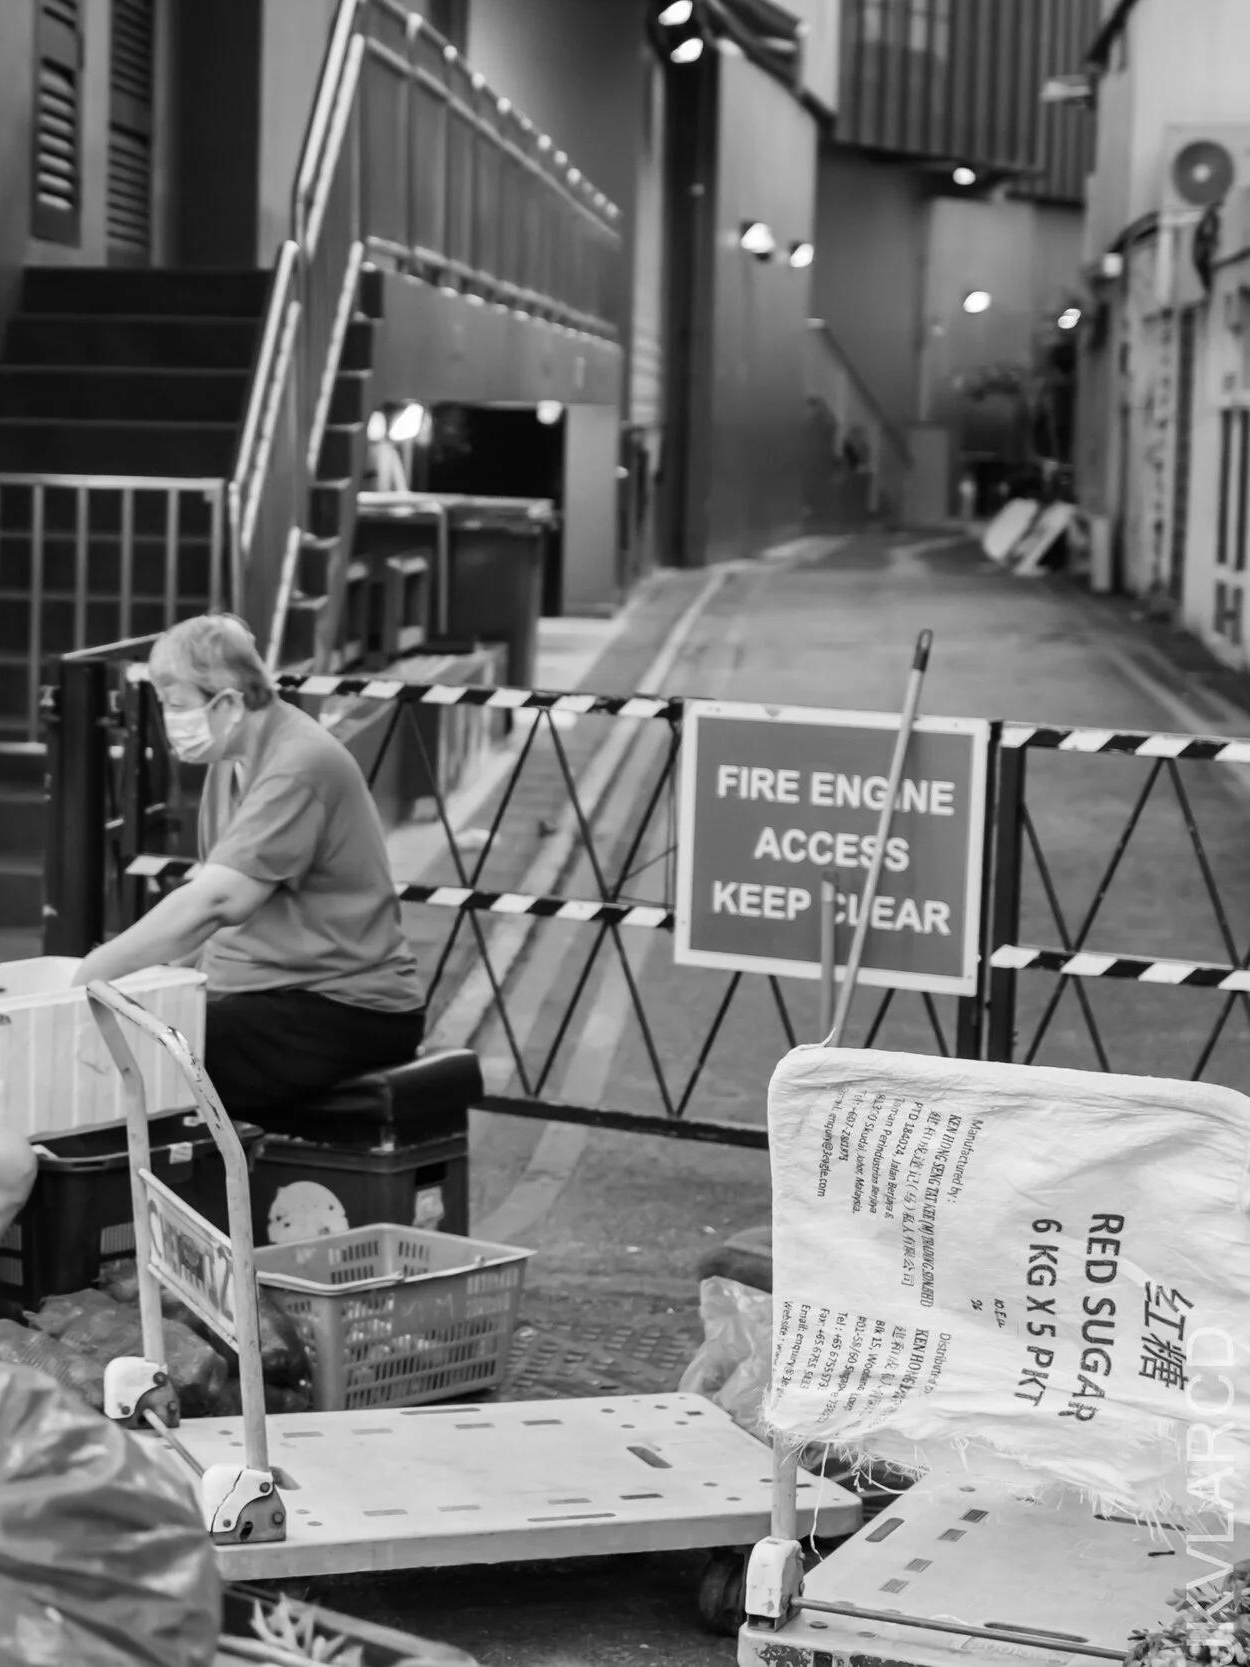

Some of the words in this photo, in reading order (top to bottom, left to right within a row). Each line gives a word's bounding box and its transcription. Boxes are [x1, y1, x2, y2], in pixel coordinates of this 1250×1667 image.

[717, 764, 800, 804] FIRE
[810, 771, 955, 816] ENGNE
[754, 826, 910, 872] ACCESS
[711, 880, 811, 920] KEEP
[909, 1101, 924, 1121] PTD
[946, 1114, 962, 1135] KEN
[892, 1121, 916, 1158] 184024,
[938, 1134, 955, 1162] HONG
[953, 1118, 984, 1187] Manufactured
[872, 1128, 892, 1184] Perindustrian
[888, 1158, 902, 1182] Jalan
[930, 1161, 946, 1187] SENG
[852, 1176, 865, 1214] Malaysia.
[884, 1181, 899, 1211] Berjaya
[925, 1187, 940, 1203] TAT
[923, 1203, 937, 1221] KEE
[1031, 1218, 1063, 1234] 6
[918, 1220, 935, 1235] (M)
[1087, 1213, 1125, 1284] RED
[1026, 1244, 1059, 1287] KG
[779, 1300, 794, 1337] Website
[798, 1304, 811, 1333] Email:
[1026, 1295, 1057, 1316] X
[831, 1332, 842, 1350] +65
[869, 1335, 882, 1351] 15,
[912, 1328, 929, 1353] KEN
[1026, 1323, 1056, 1342] 5
[1138, 1280, 1195, 1392] 红糖
[902, 1352, 925, 1385] HONG
[931, 1332, 951, 1386] Distributed
[1058, 1296, 1117, 1422] SUGAR
[1014, 1346, 1054, 1407] PKT
